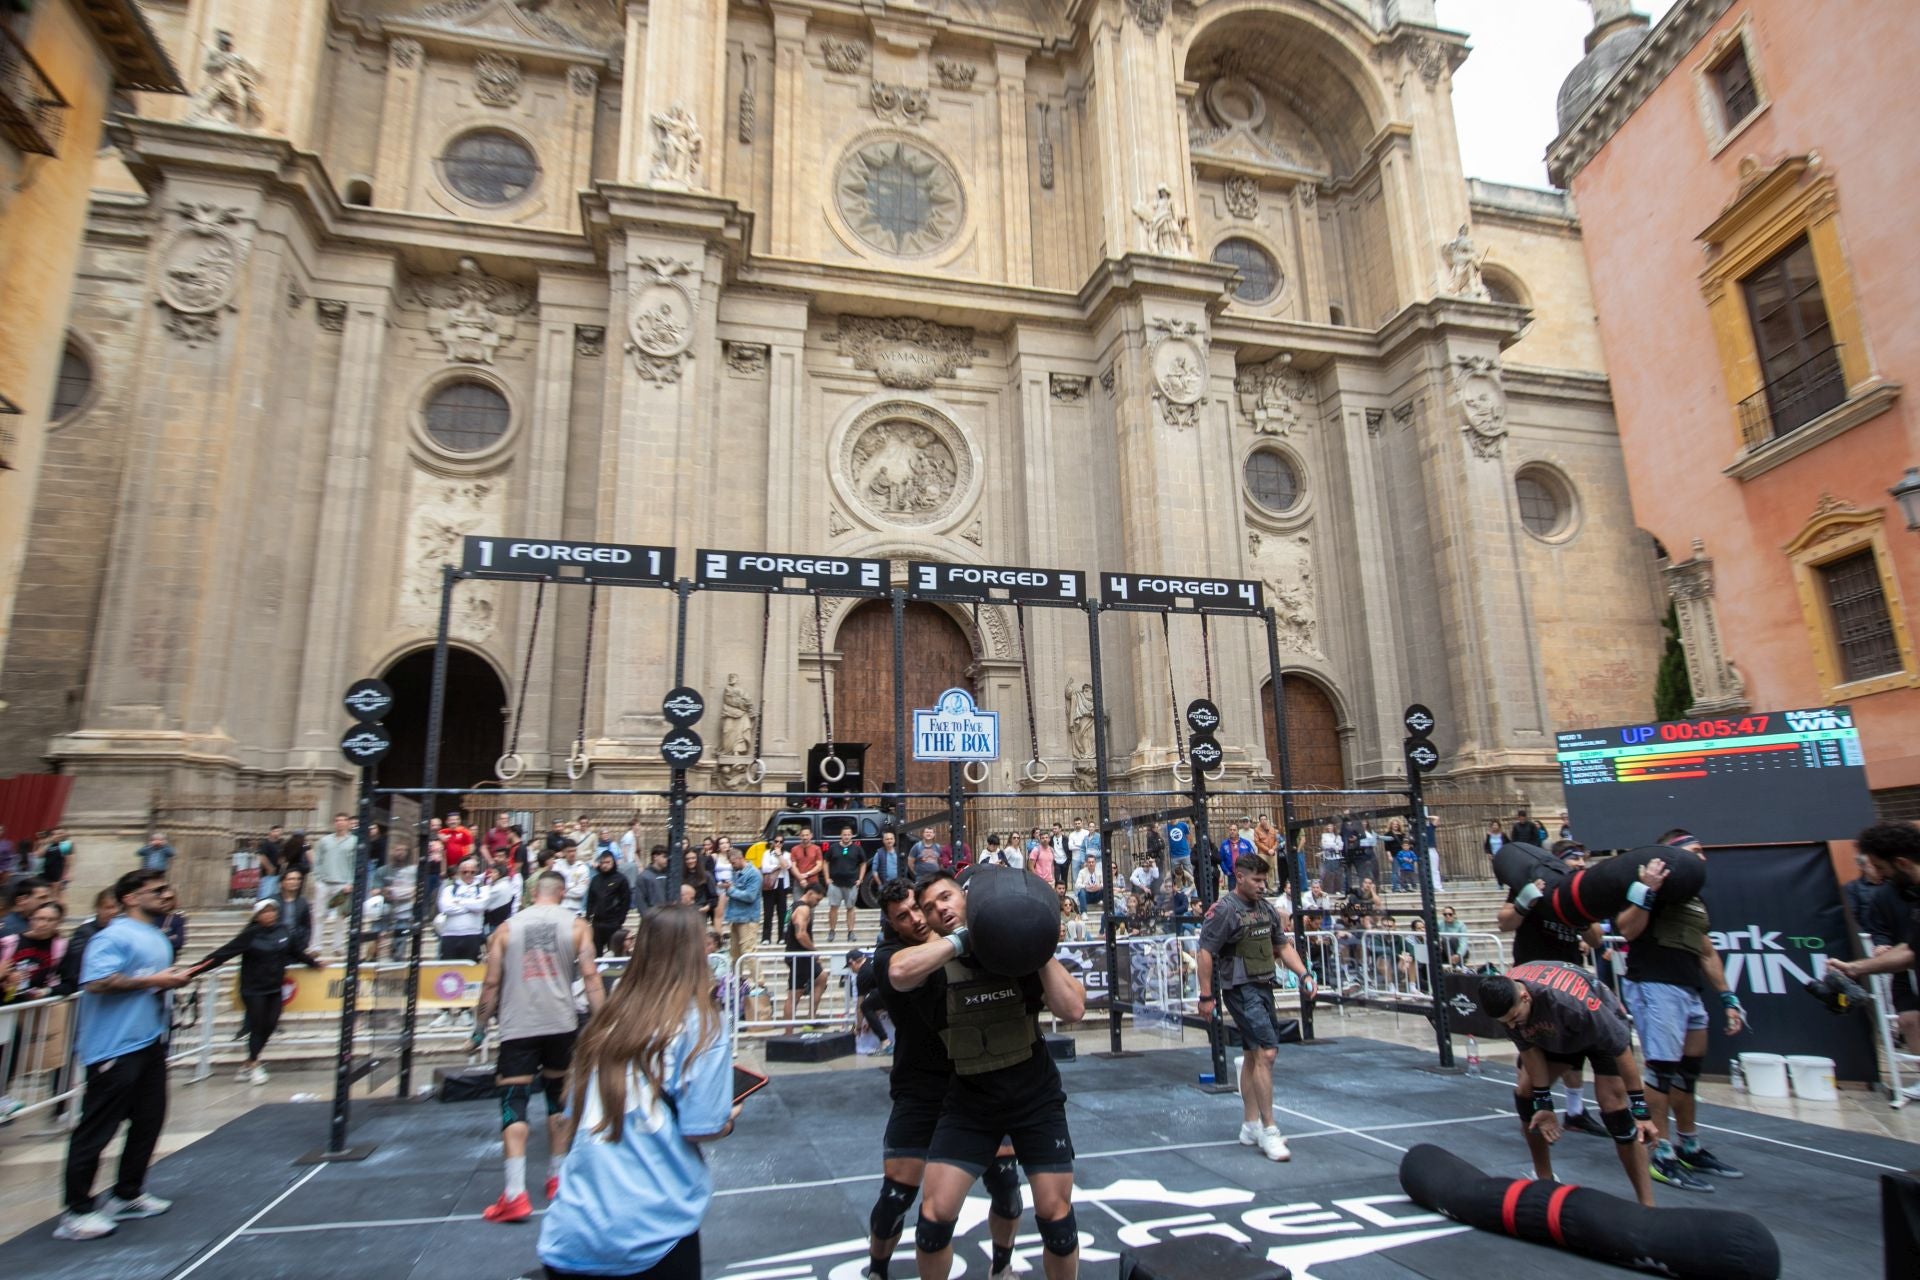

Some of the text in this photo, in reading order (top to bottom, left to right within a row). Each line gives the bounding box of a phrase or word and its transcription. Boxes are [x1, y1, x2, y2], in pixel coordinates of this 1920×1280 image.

[479, 541, 661, 576] 1 FORGED 1
[706, 554, 880, 587] 2 FORGED 2
[918, 566, 1077, 597] 3 FORGED 3
[1110, 577, 1256, 606] 4 FORGED 4
[1189, 713, 1218, 721] FORGED
[1660, 716, 1770, 741] 00:05:47
[1787, 715, 1853, 732] WIN
[921, 732, 991, 752] THE BOX
[1620, 726, 1656, 744] UP
[1707, 924, 1825, 951] ark TO
[980, 988, 1017, 1002] PICSIL
